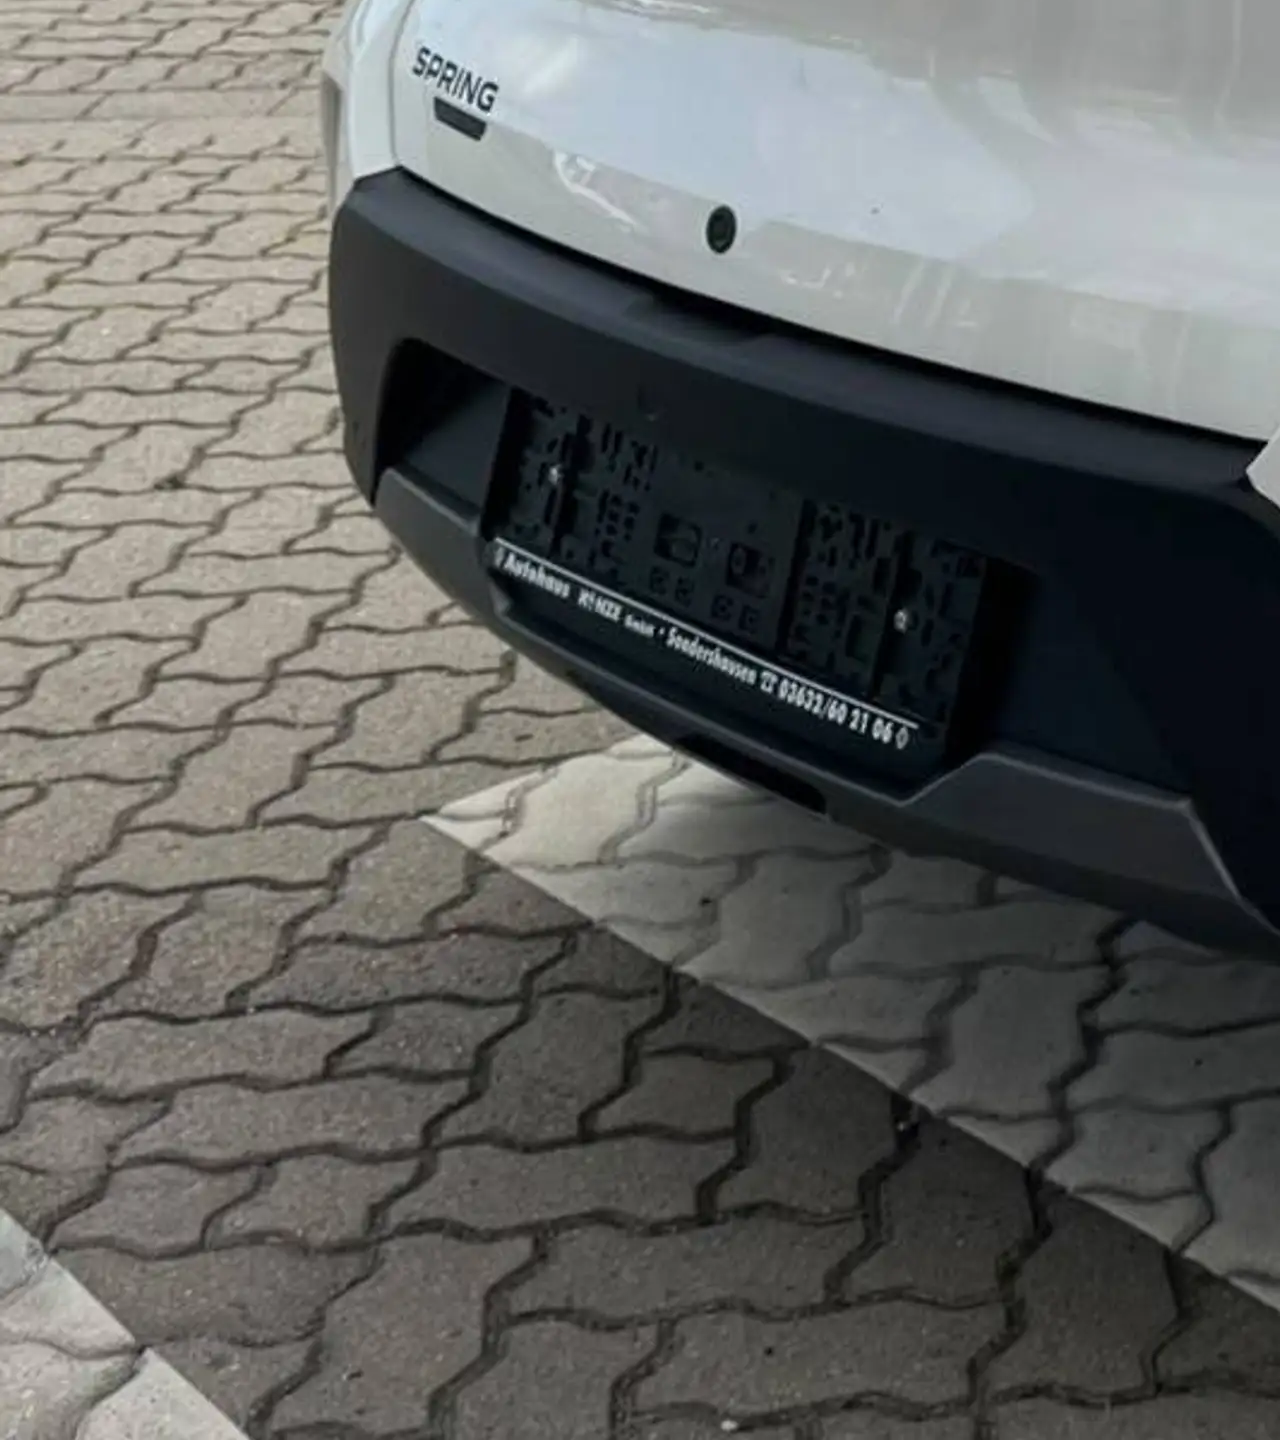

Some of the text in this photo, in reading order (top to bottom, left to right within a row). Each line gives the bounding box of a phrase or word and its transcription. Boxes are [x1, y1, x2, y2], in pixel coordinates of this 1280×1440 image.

[412, 46, 499, 113] SPRING
[504, 552, 571, 598] Autohaus
[666, 626, 757, 686] Sondershausen
[850, 707, 869, 734] 21
